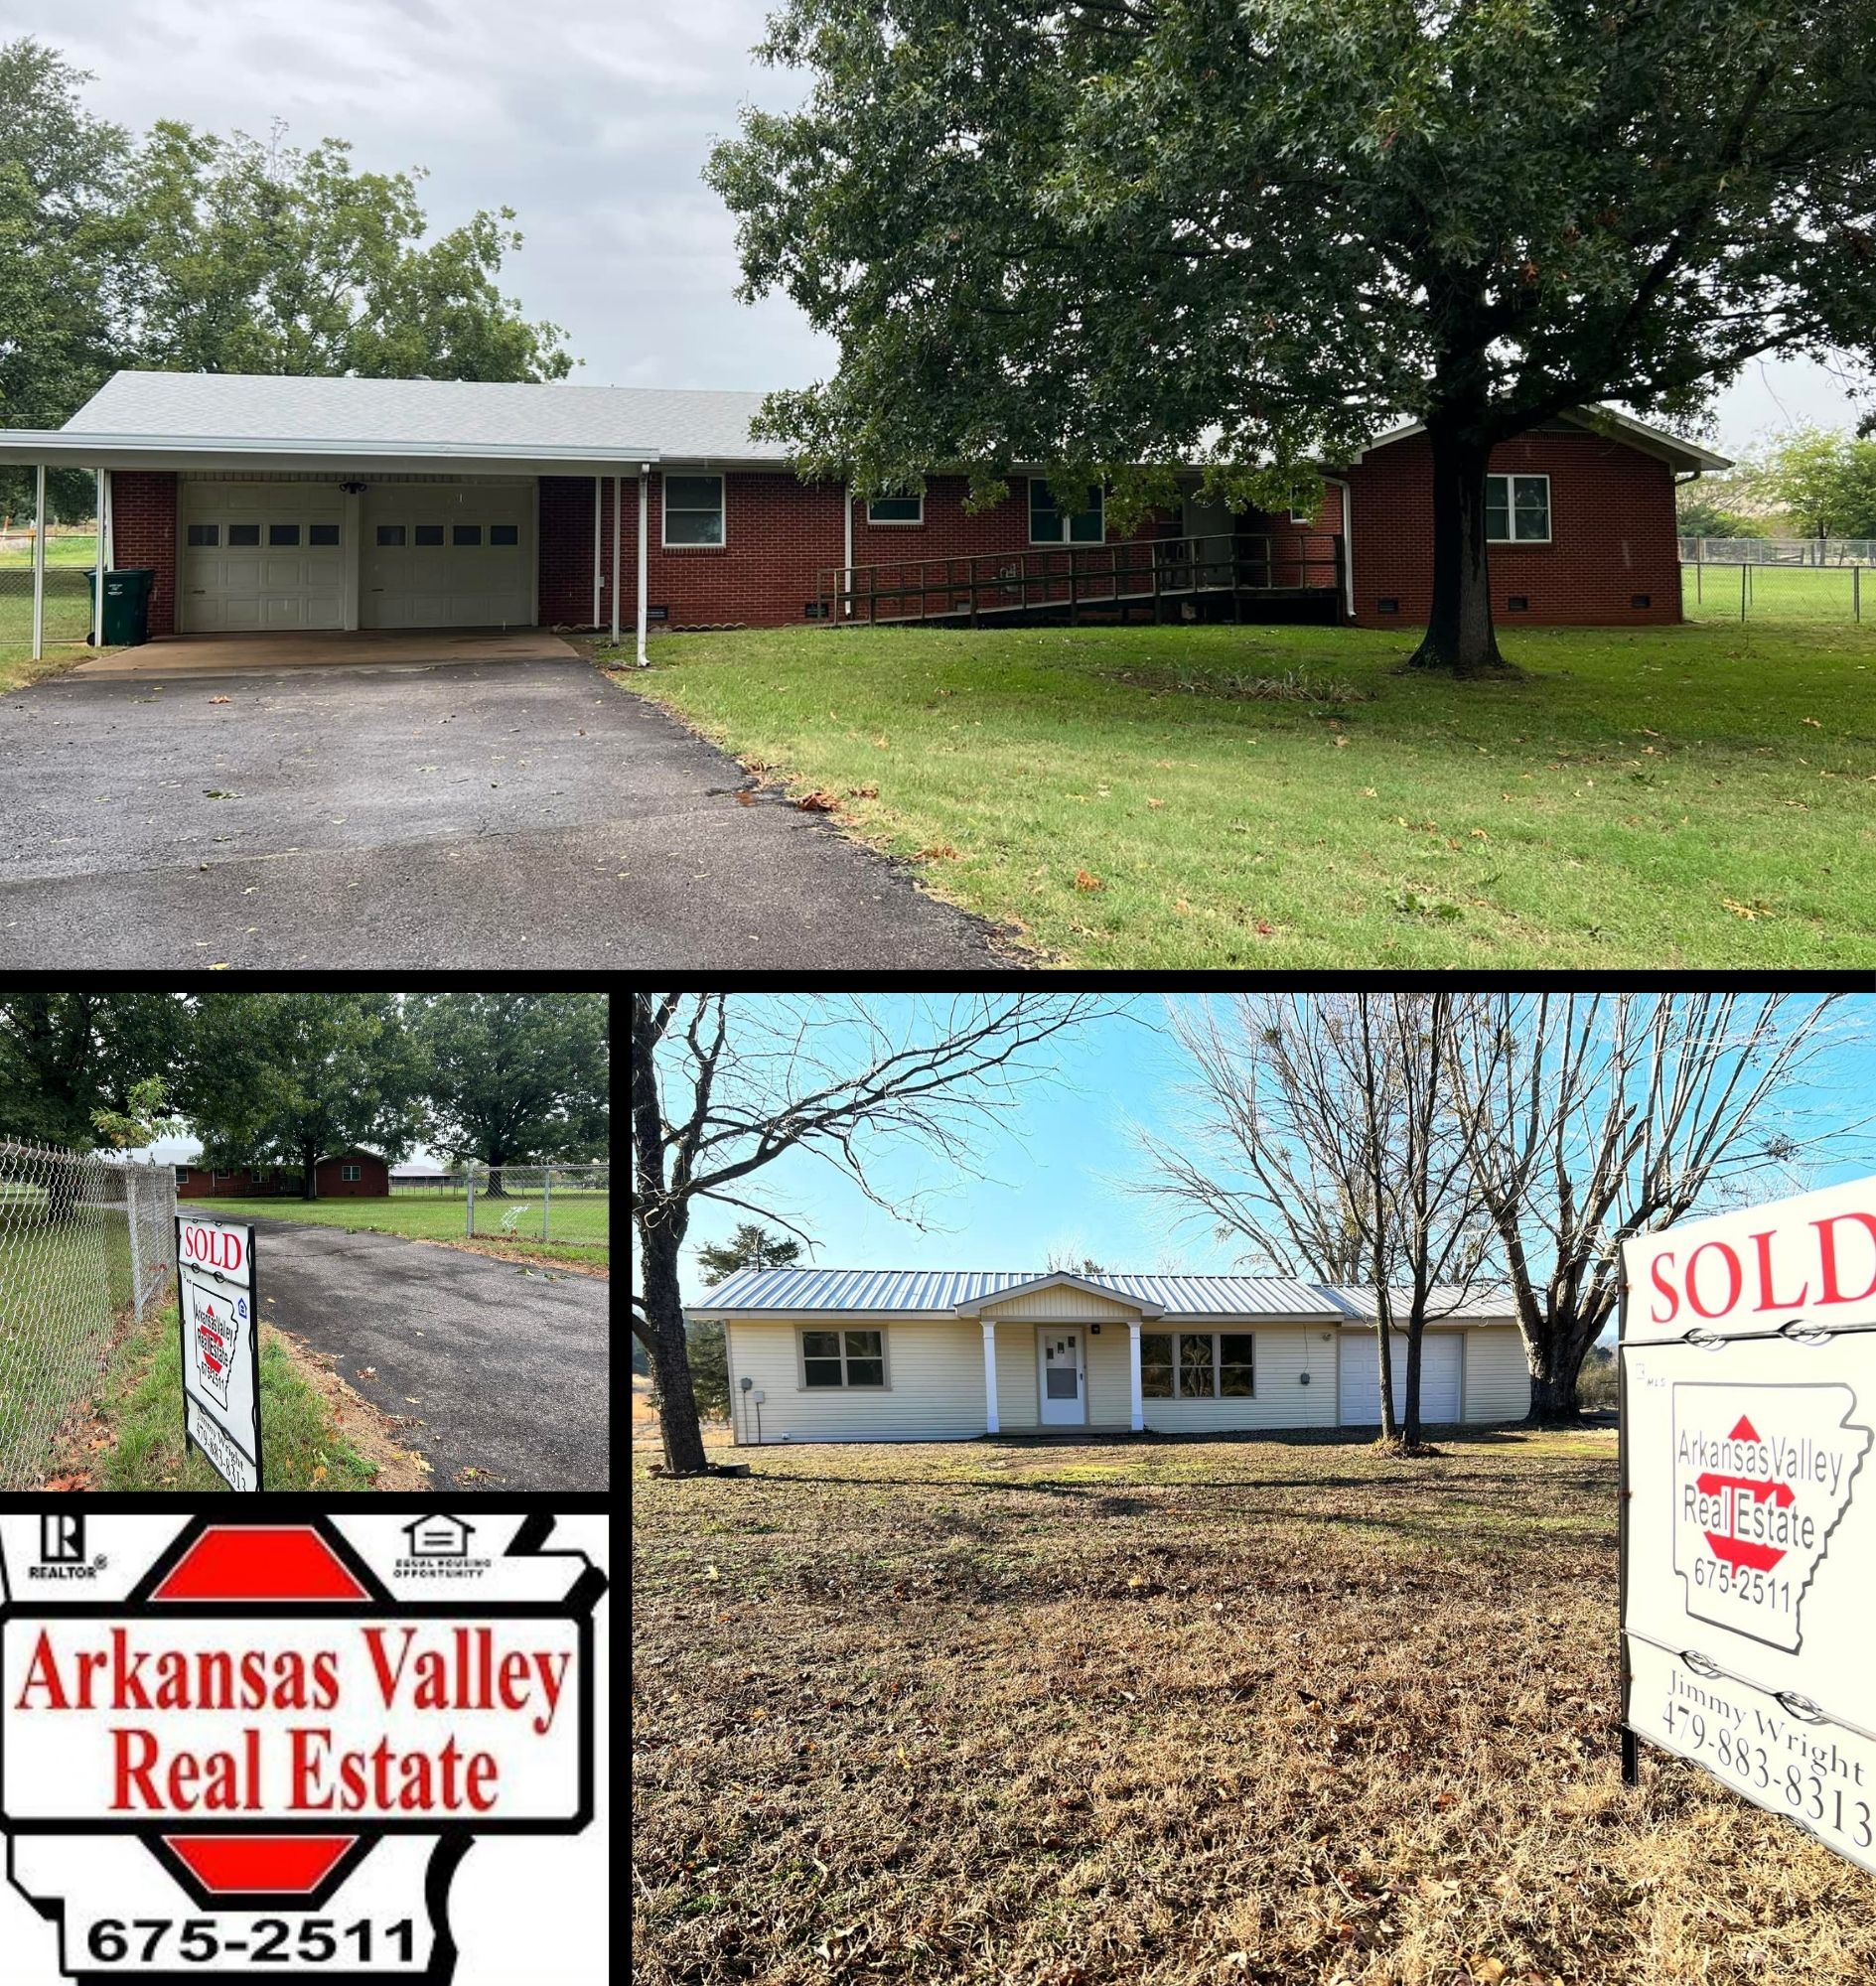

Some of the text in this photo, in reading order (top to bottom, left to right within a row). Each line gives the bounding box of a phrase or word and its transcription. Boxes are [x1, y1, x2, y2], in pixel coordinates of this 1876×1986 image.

[185, 1226, 242, 1270] SOLD
[1651, 1211, 1876, 1324] SOLD
[1684, 1484, 1815, 1550] Real Estate
[1694, 1557, 1790, 1614] 675-2511
[1667, 1669, 1865, 1786] Jimmy Wright
[1662, 1700, 1873, 1848] 479-883-8313
